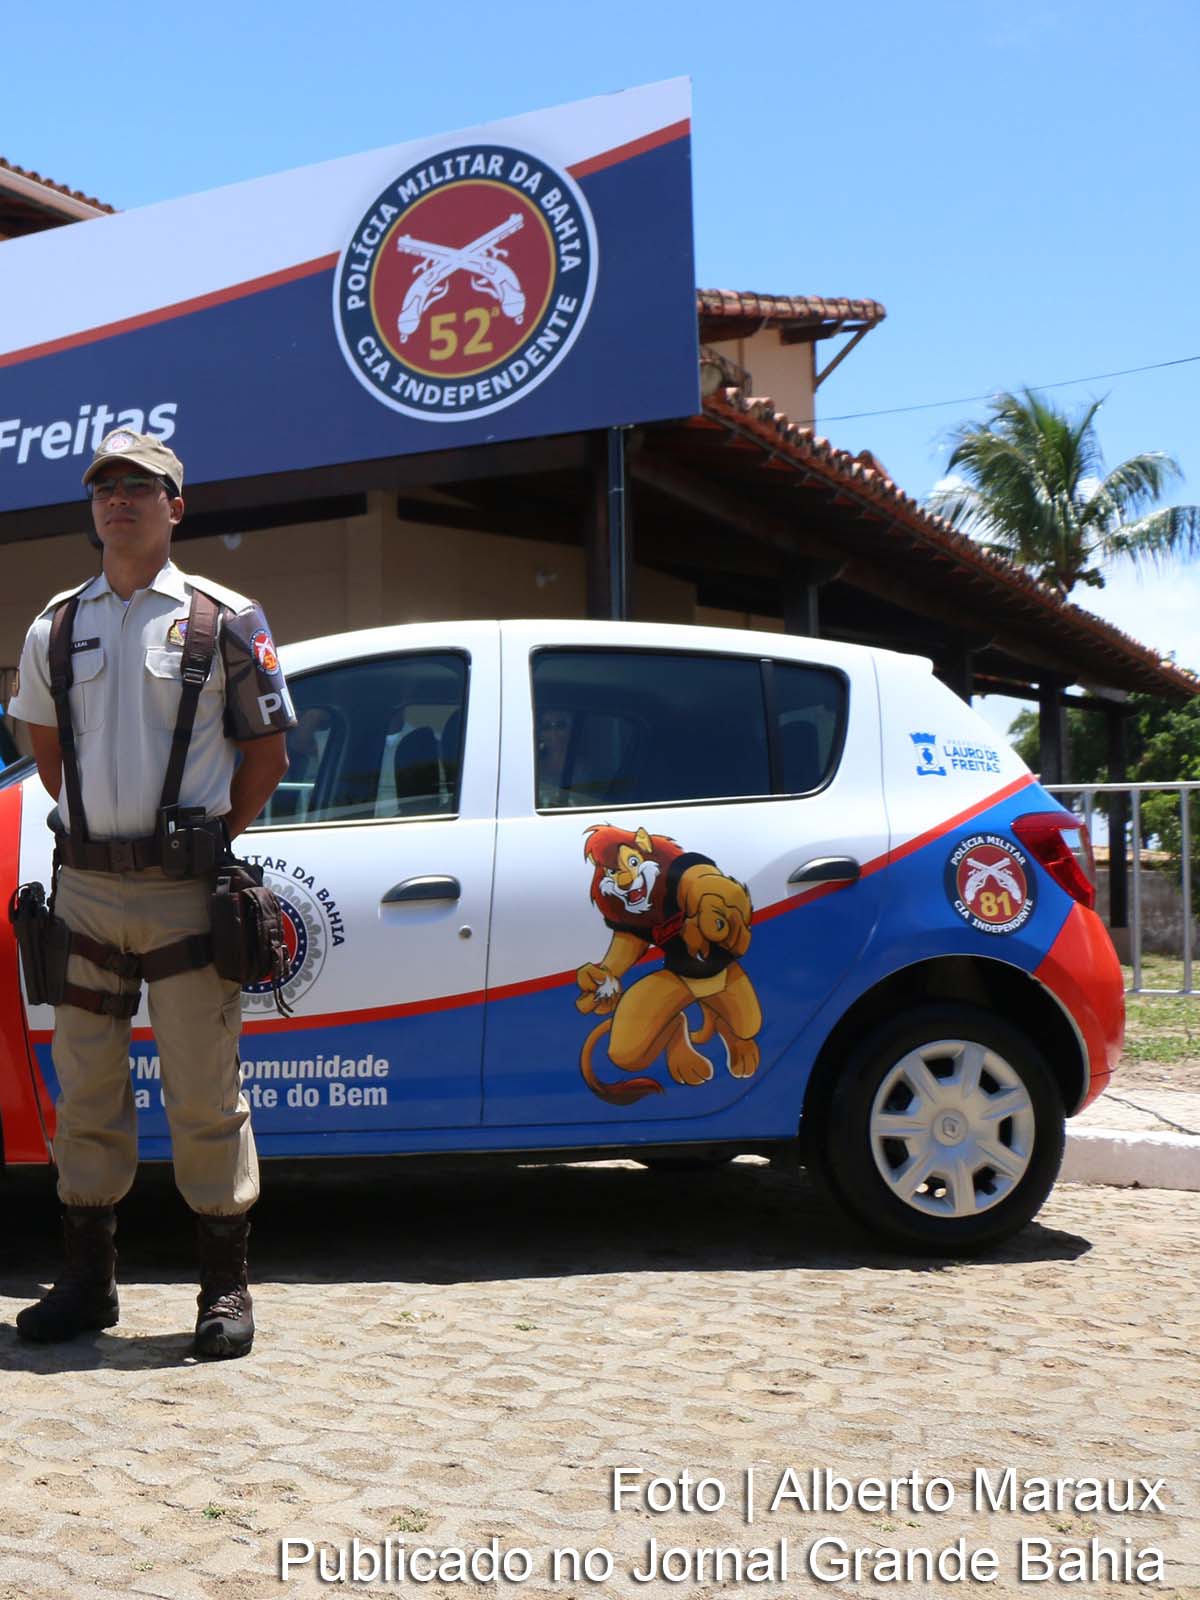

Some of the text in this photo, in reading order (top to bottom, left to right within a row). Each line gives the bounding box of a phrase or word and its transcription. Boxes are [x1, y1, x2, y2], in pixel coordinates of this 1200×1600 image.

[346, 153, 582, 311] POLÍCIA MILITAR DA BAHIA
[356, 293, 578, 407] CIA INDEPENDENTE
[943, 745, 1001, 763] LAURO DE
[951, 758, 1001, 774] FREITAS
[950, 835, 1027, 866] POLÍCIA MILITAR
[291, 865, 316, 889] DA
[315, 887, 345, 947] BAHIA
[954, 898, 1034, 934] CIA INDEPENDENTE
[980, 891, 1012, 917] 81
[240, 1053, 390, 1080] omunidade
[286, 1083, 320, 1108] do
[329, 1082, 388, 1107] Bem
